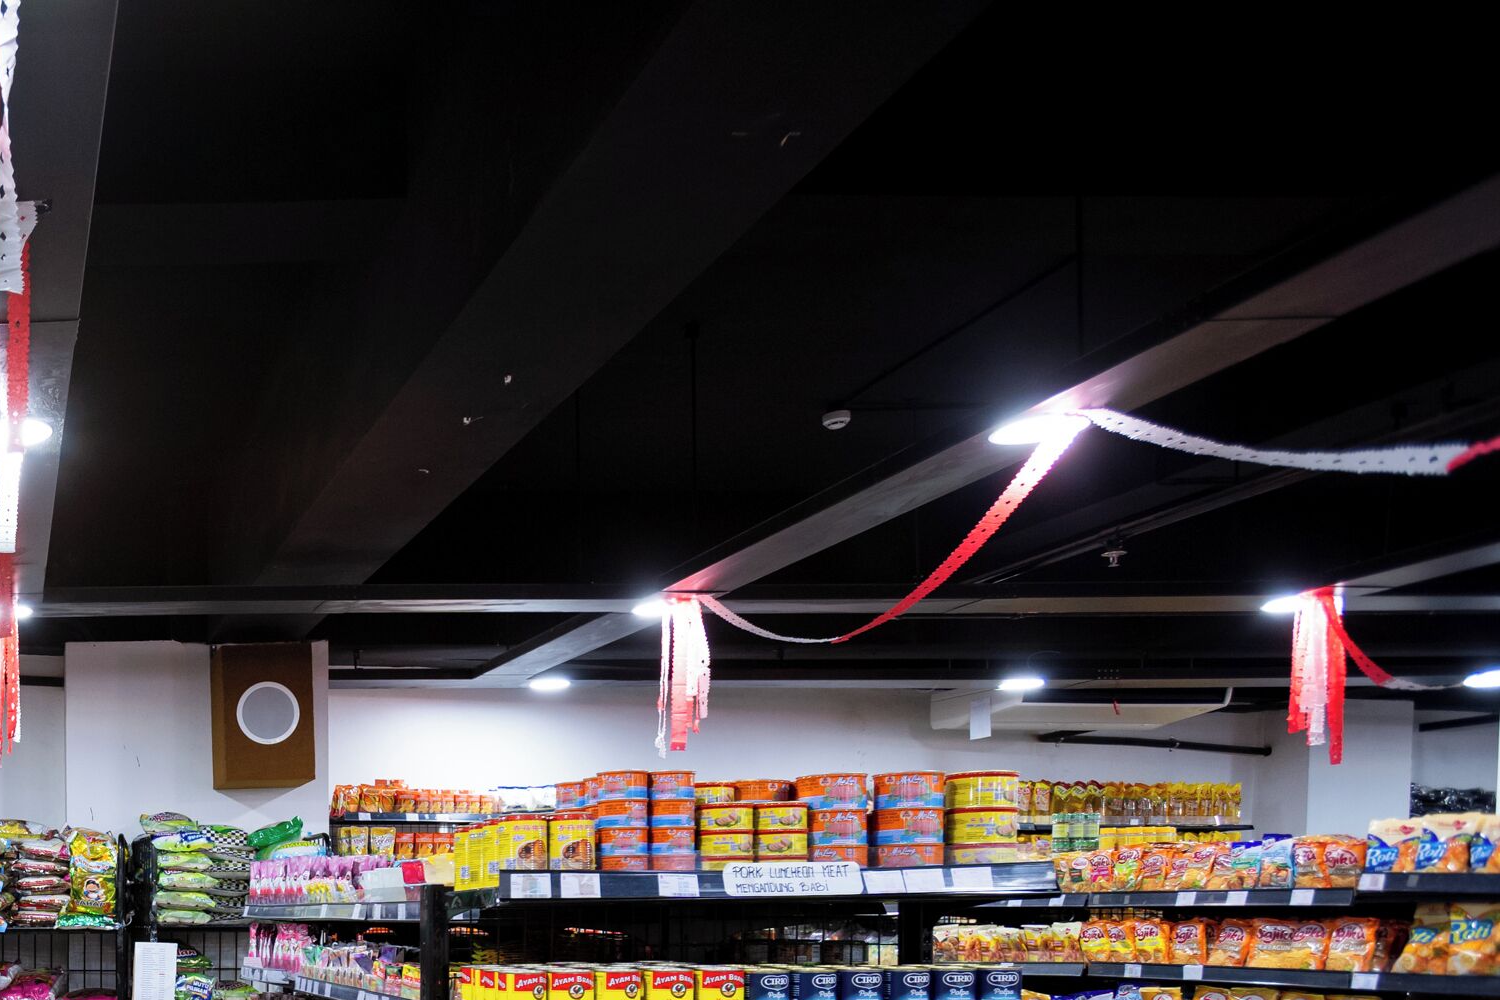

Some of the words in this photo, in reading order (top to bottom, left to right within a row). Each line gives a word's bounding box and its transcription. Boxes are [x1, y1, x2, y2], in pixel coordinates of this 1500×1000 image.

[1366, 848, 1397, 867] Roti
[732, 867, 763, 878] PORK
[770, 866, 813, 878] LUNCHEON
[822, 865, 849, 878] MEAT
[736, 883, 794, 892] MENGANDUNG
[1450, 921, 1492, 944] Roti
[553, 976, 574, 986] AYAM
[654, 975, 676, 985] AYAM
[703, 975, 726, 985] AYAM
[855, 975, 880, 984] CIRIO
[946, 974, 972, 983] CIRIO
[989, 973, 1017, 983] CIRIO
[950, 988, 969, 996] Polpa
[994, 987, 1014, 996] Polpa
